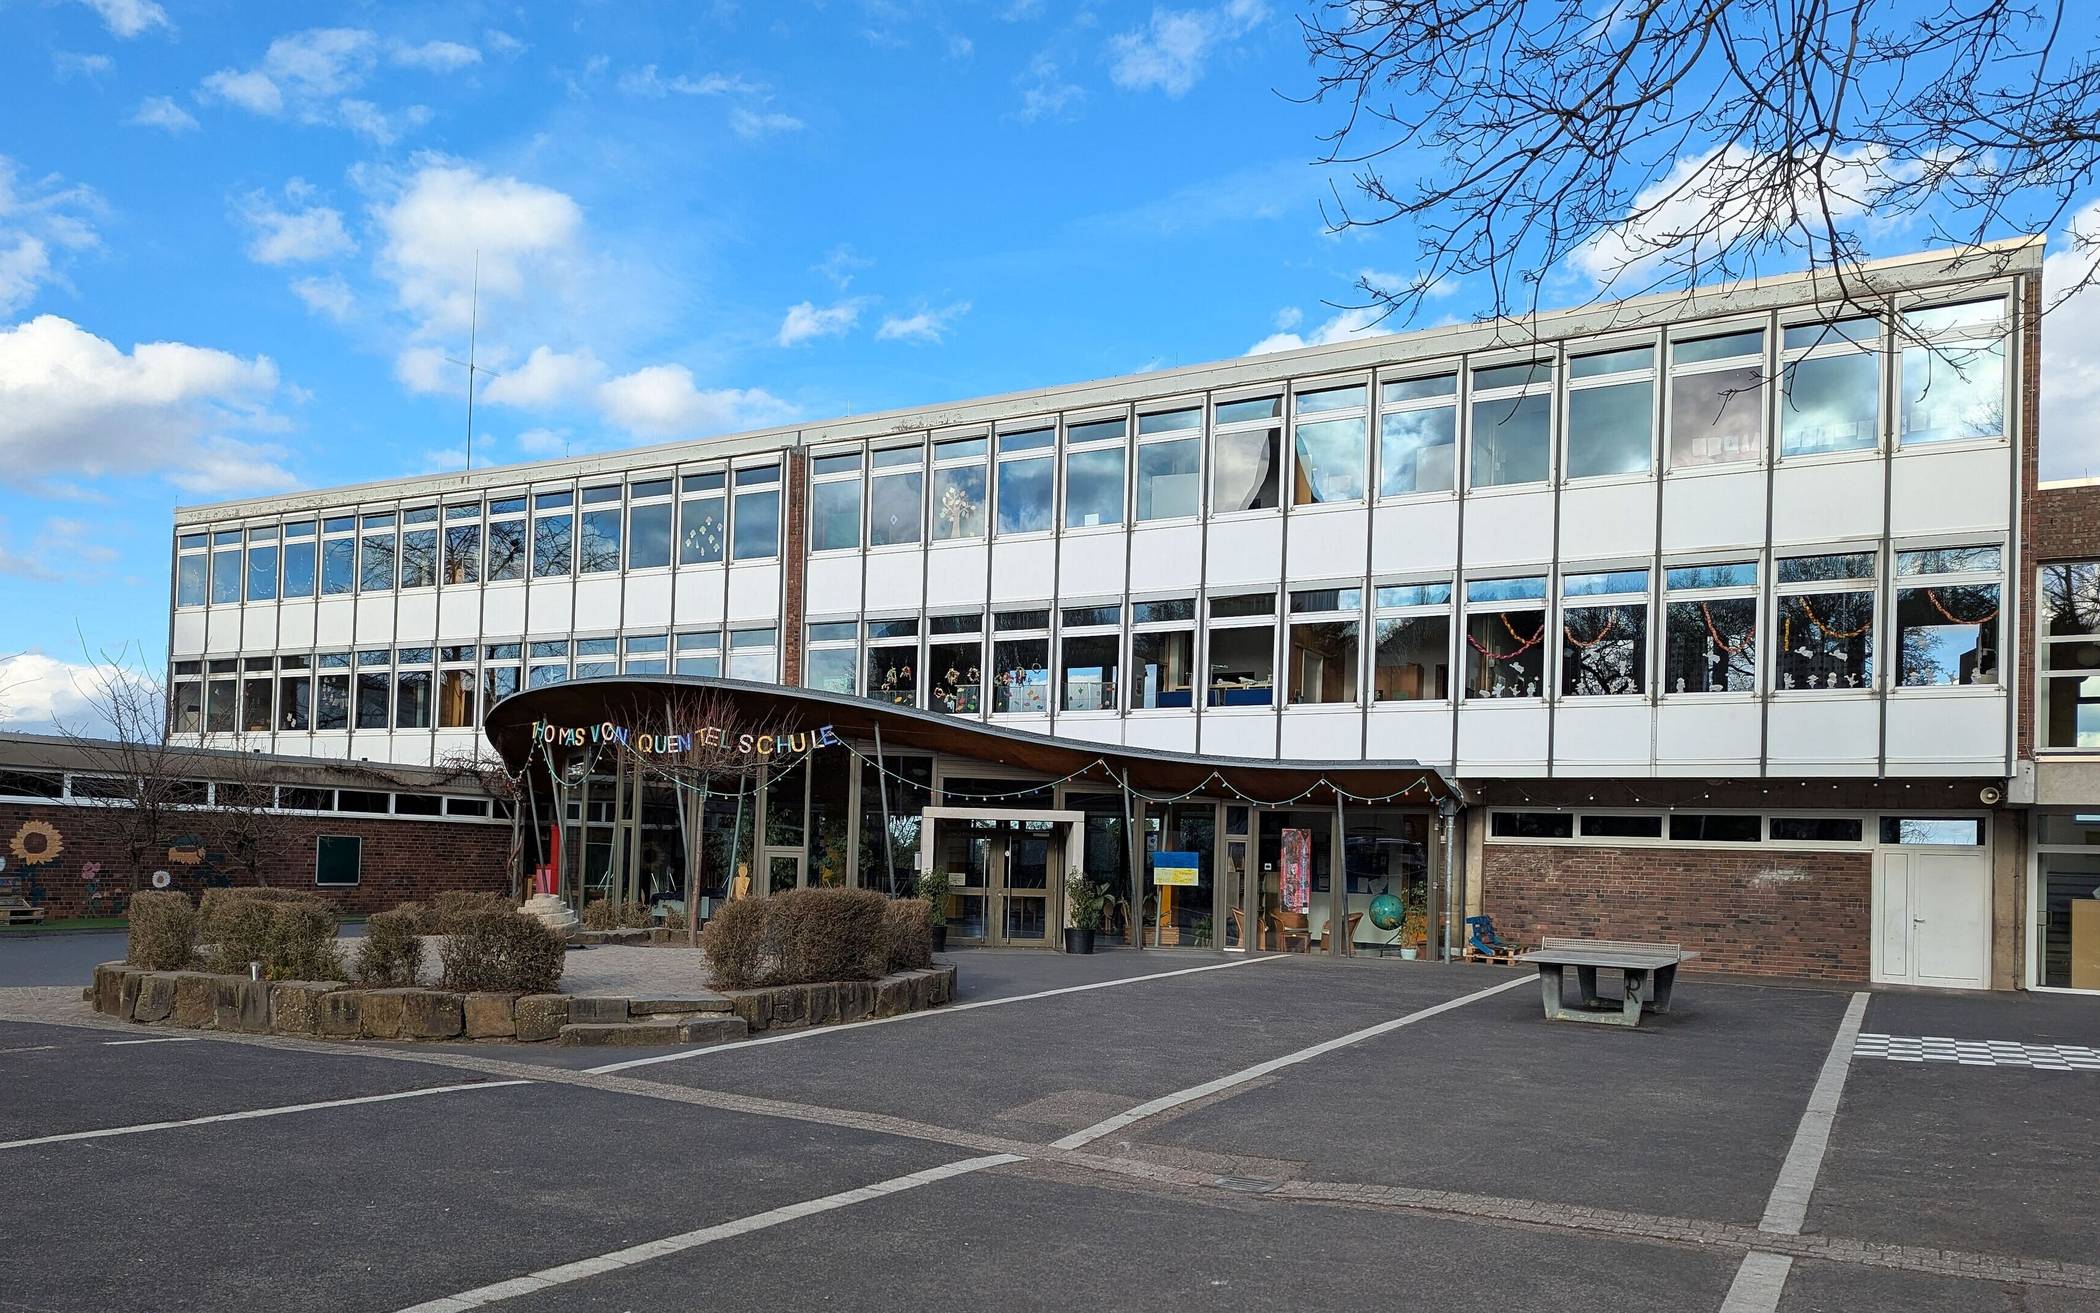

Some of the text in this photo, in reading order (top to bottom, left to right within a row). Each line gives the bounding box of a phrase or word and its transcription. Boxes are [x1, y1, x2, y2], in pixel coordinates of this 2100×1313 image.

[532, 721, 585, 746] THOMAS
[590, 722, 629, 746] VON
[738, 724, 838, 755] SCHULE
